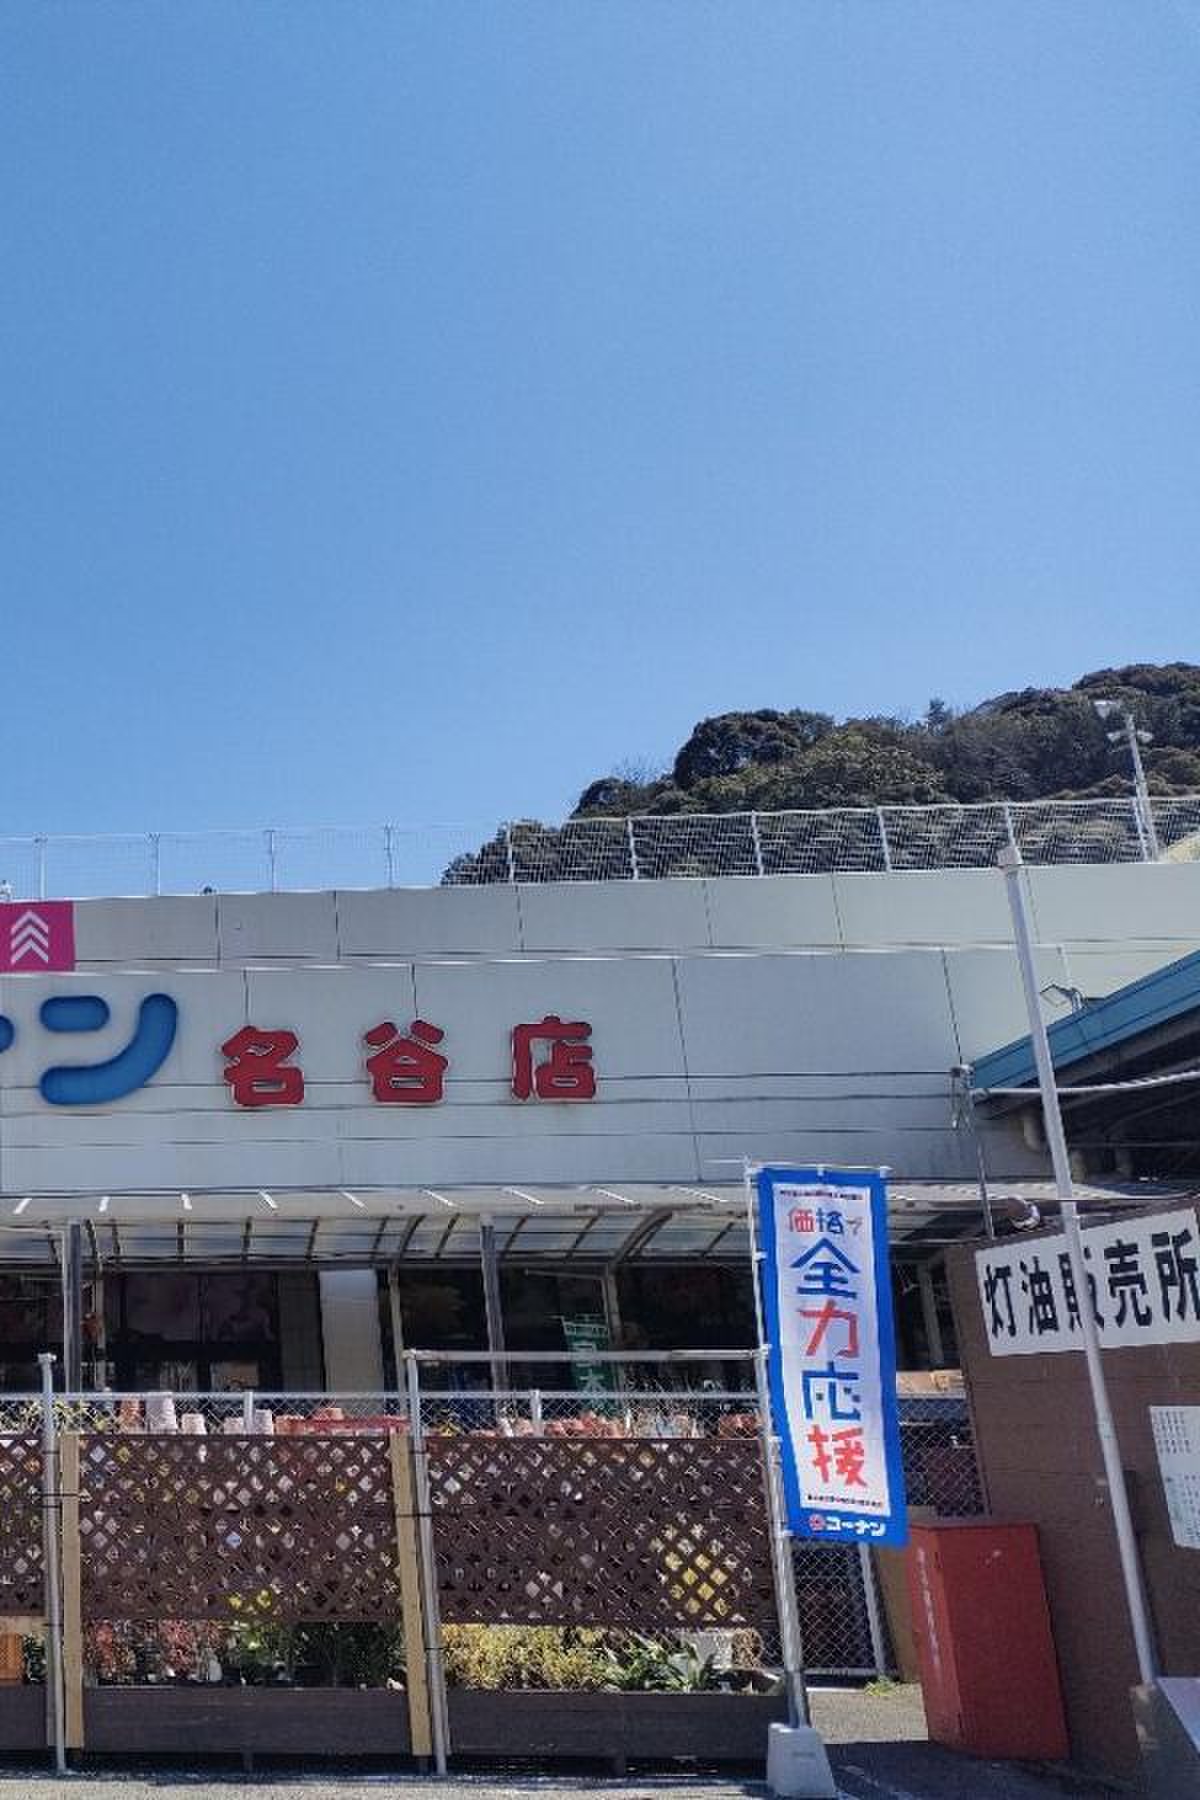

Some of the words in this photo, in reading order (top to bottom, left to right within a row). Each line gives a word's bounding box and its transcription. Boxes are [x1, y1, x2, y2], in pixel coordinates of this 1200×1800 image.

[221, 1014, 597, 1107] 名谷店
[789, 1237, 869, 1488] 全力応援
[826, 1516, 886, 1537] コーナン
